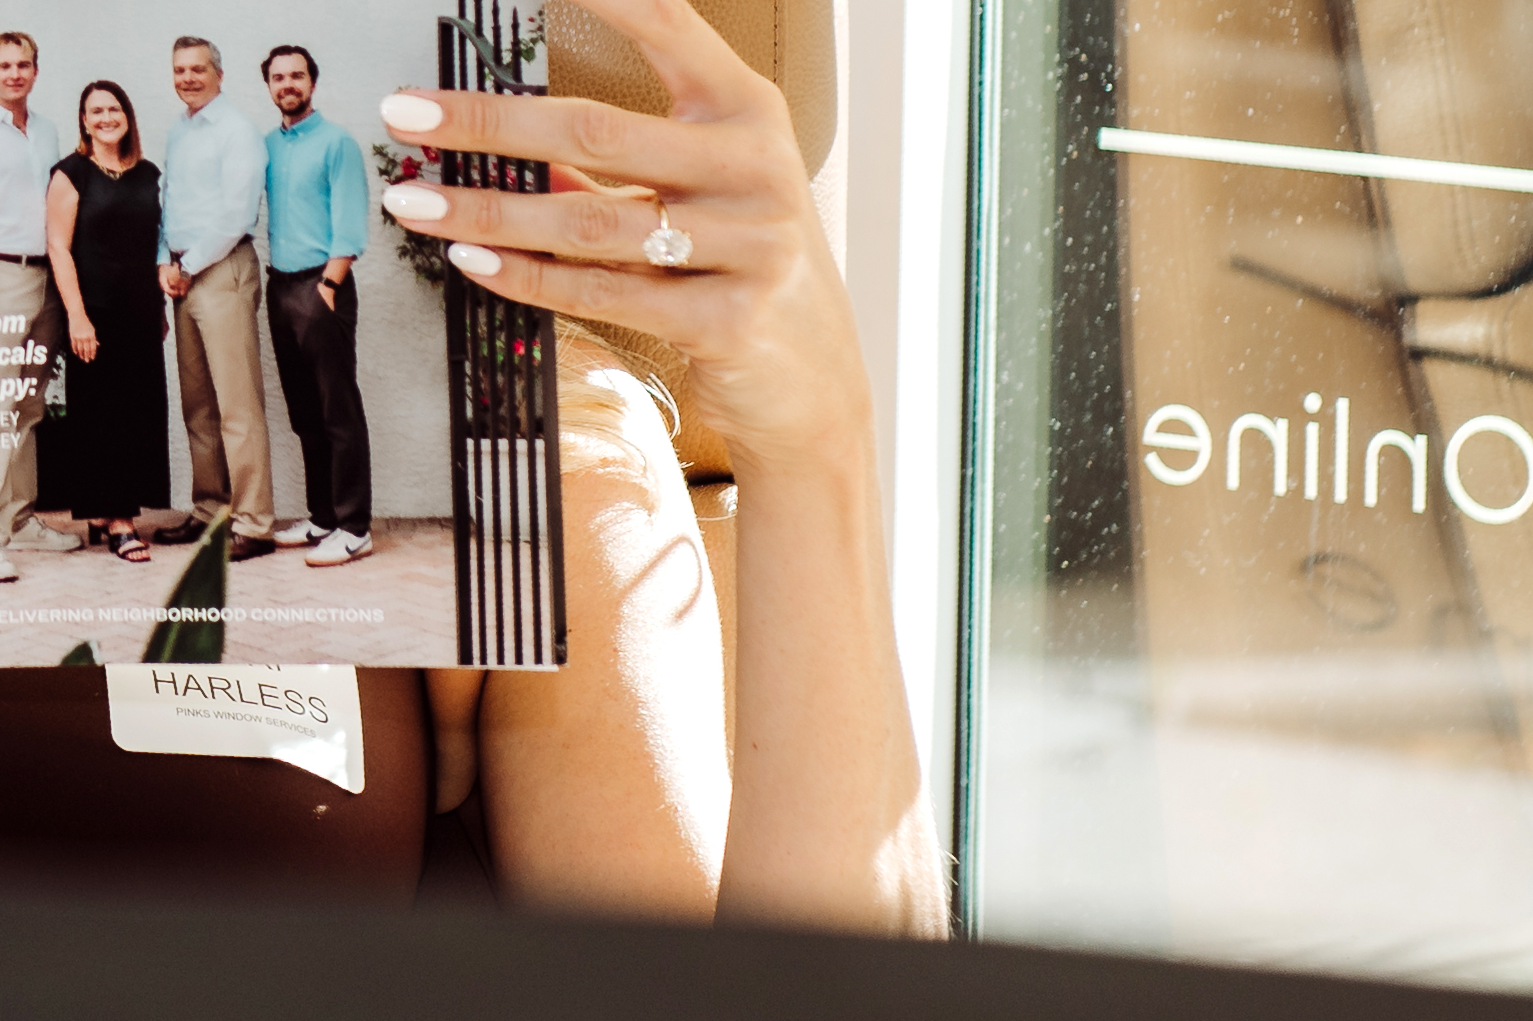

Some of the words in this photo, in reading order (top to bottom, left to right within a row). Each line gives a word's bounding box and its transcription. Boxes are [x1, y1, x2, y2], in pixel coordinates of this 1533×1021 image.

[98, 607, 246, 622] NEIGHBORHOOD
[250, 607, 384, 622] CONNECTIONS
[153, 669, 329, 724] HARLESS
[176, 706, 211, 720] PINKS
[213, 709, 263, 724] WINDOW
[265, 716, 317, 738] SERVICES
